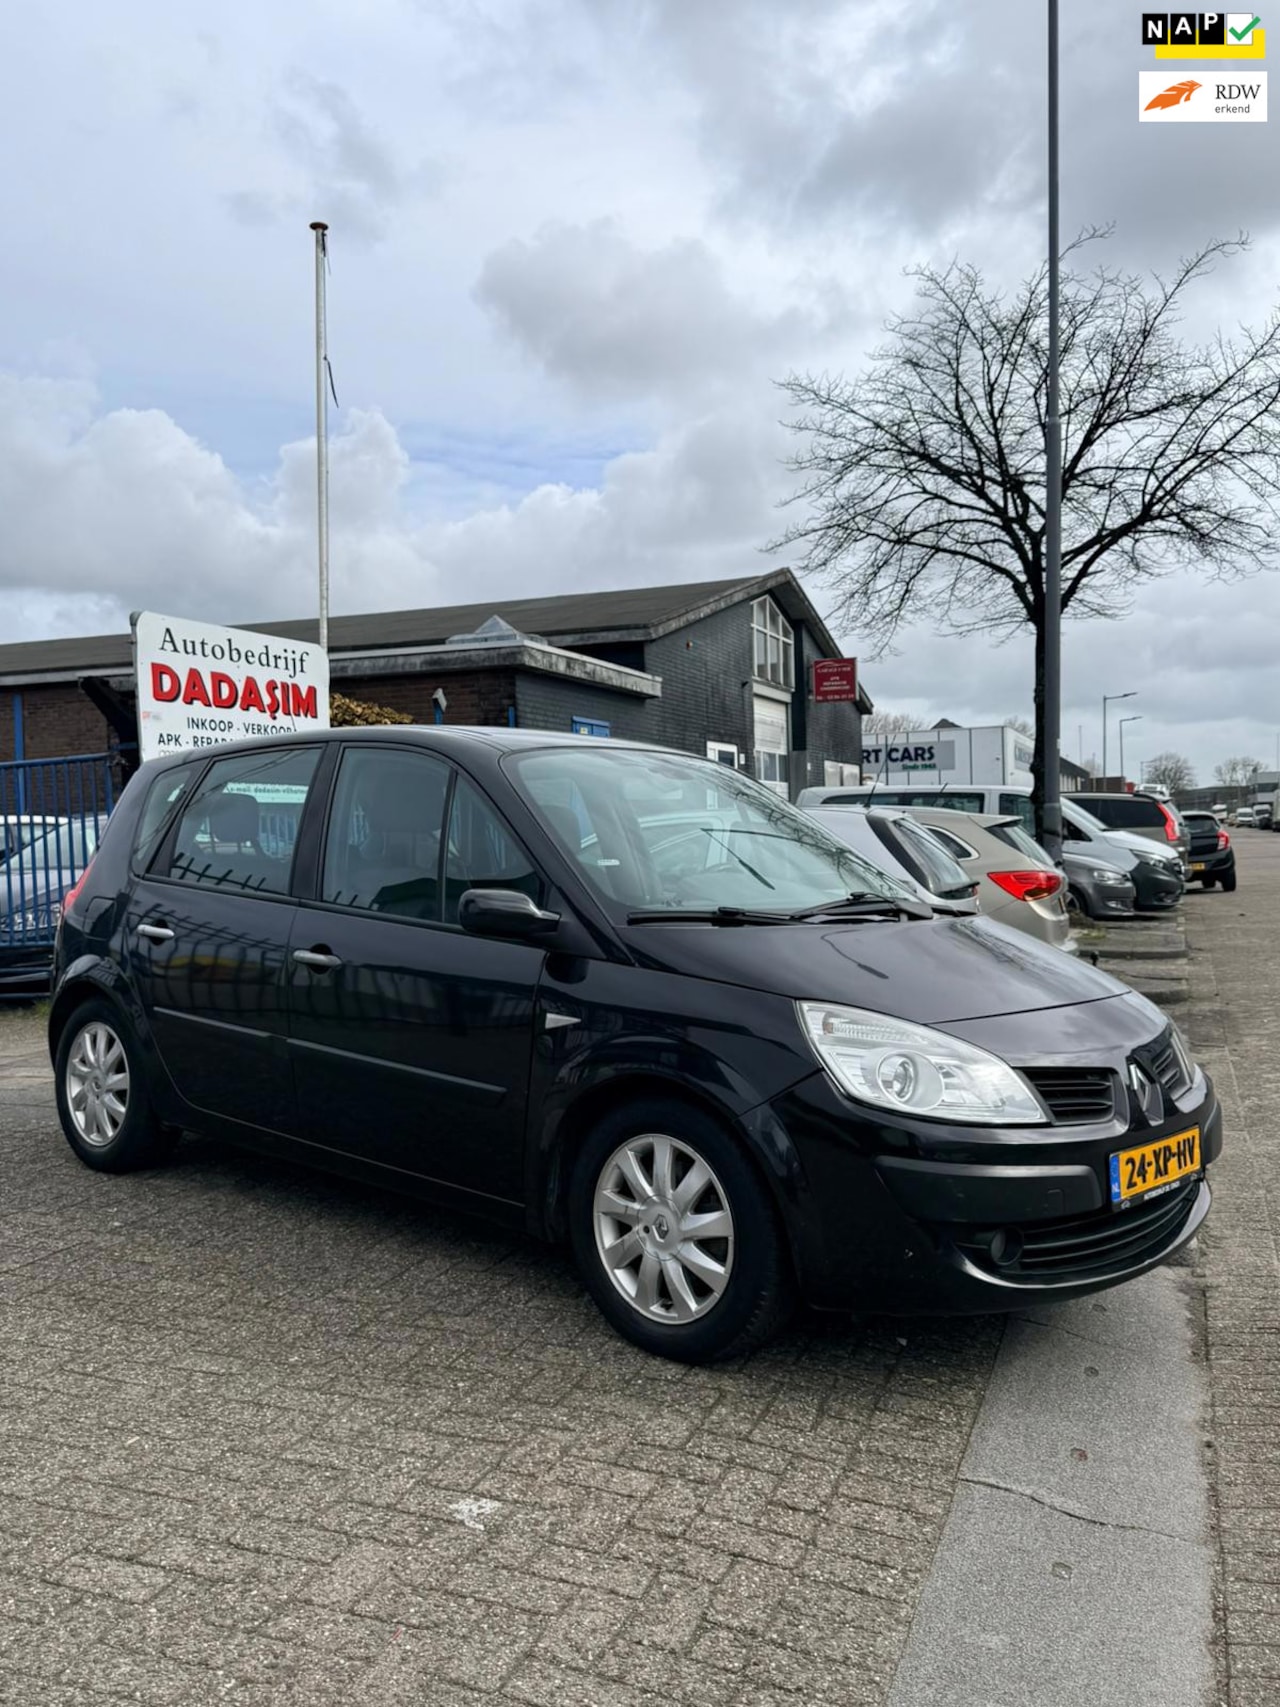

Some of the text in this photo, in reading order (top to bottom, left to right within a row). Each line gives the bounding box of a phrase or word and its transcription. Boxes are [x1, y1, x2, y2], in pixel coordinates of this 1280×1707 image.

[158, 627, 310, 678] Autobedrijf
[151, 662, 318, 720] DADAŞIM
[158, 733, 182, 747] APK
[187, 717, 234, 732] INKOOP
[887, 746, 934, 762] CARS
[1125, 1135, 1195, 1190] 24-XP-HV
